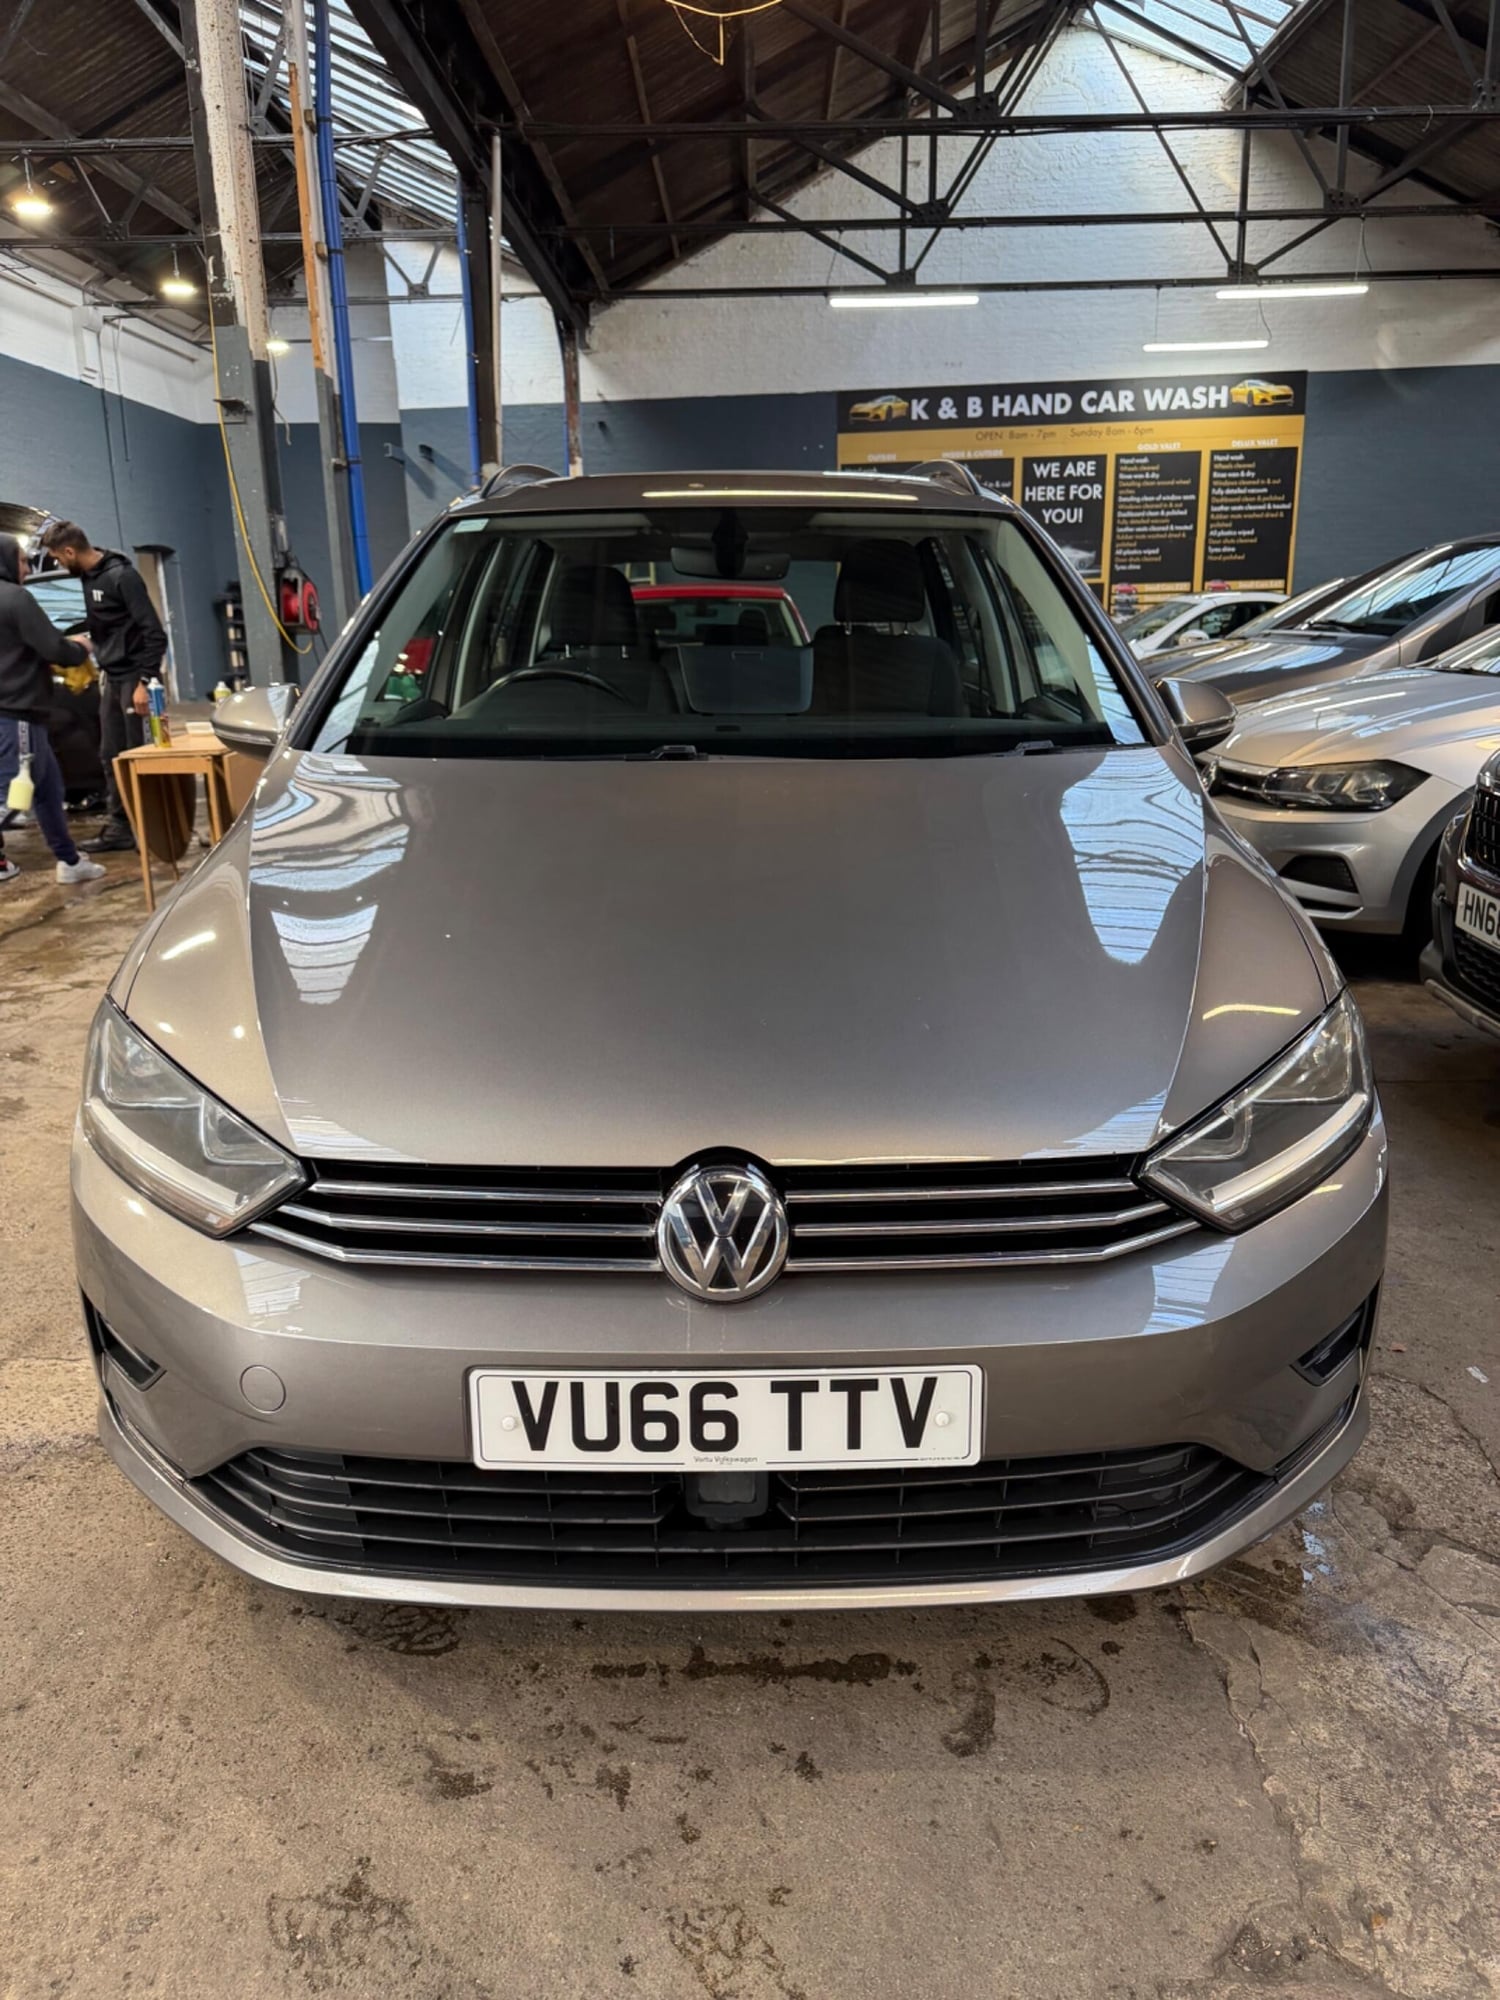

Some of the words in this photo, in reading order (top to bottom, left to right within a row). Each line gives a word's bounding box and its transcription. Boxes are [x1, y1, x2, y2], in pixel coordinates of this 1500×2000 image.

[911, 399, 929, 421] K
[938, 398, 958, 420] &
[967, 397, 983, 418] B
[992, 393, 1071, 417] HAND
[1081, 390, 1135, 414] CAR
[1144, 385, 1228, 411] WASH
[975, 431, 1002, 441] OPEN
[1008, 430, 1028, 440] 8am
[1036, 429, 1057, 442] 7pm
[1070, 427, 1102, 439] Sunday
[1105, 427, 1125, 437] 8am
[1134, 425, 1154, 438] 6pm
[1256, 438, 1278, 446] VALET
[1032, 462, 1060, 478] WE
[1063, 460, 1096, 477] ARE
[1024, 485, 1065, 502] HERE
[1069, 483, 1103, 500] FOR
[1041, 507, 1083, 524] YOU!
[510, 1380, 740, 1452] VU66
[770, 1376, 938, 1452] TTV
